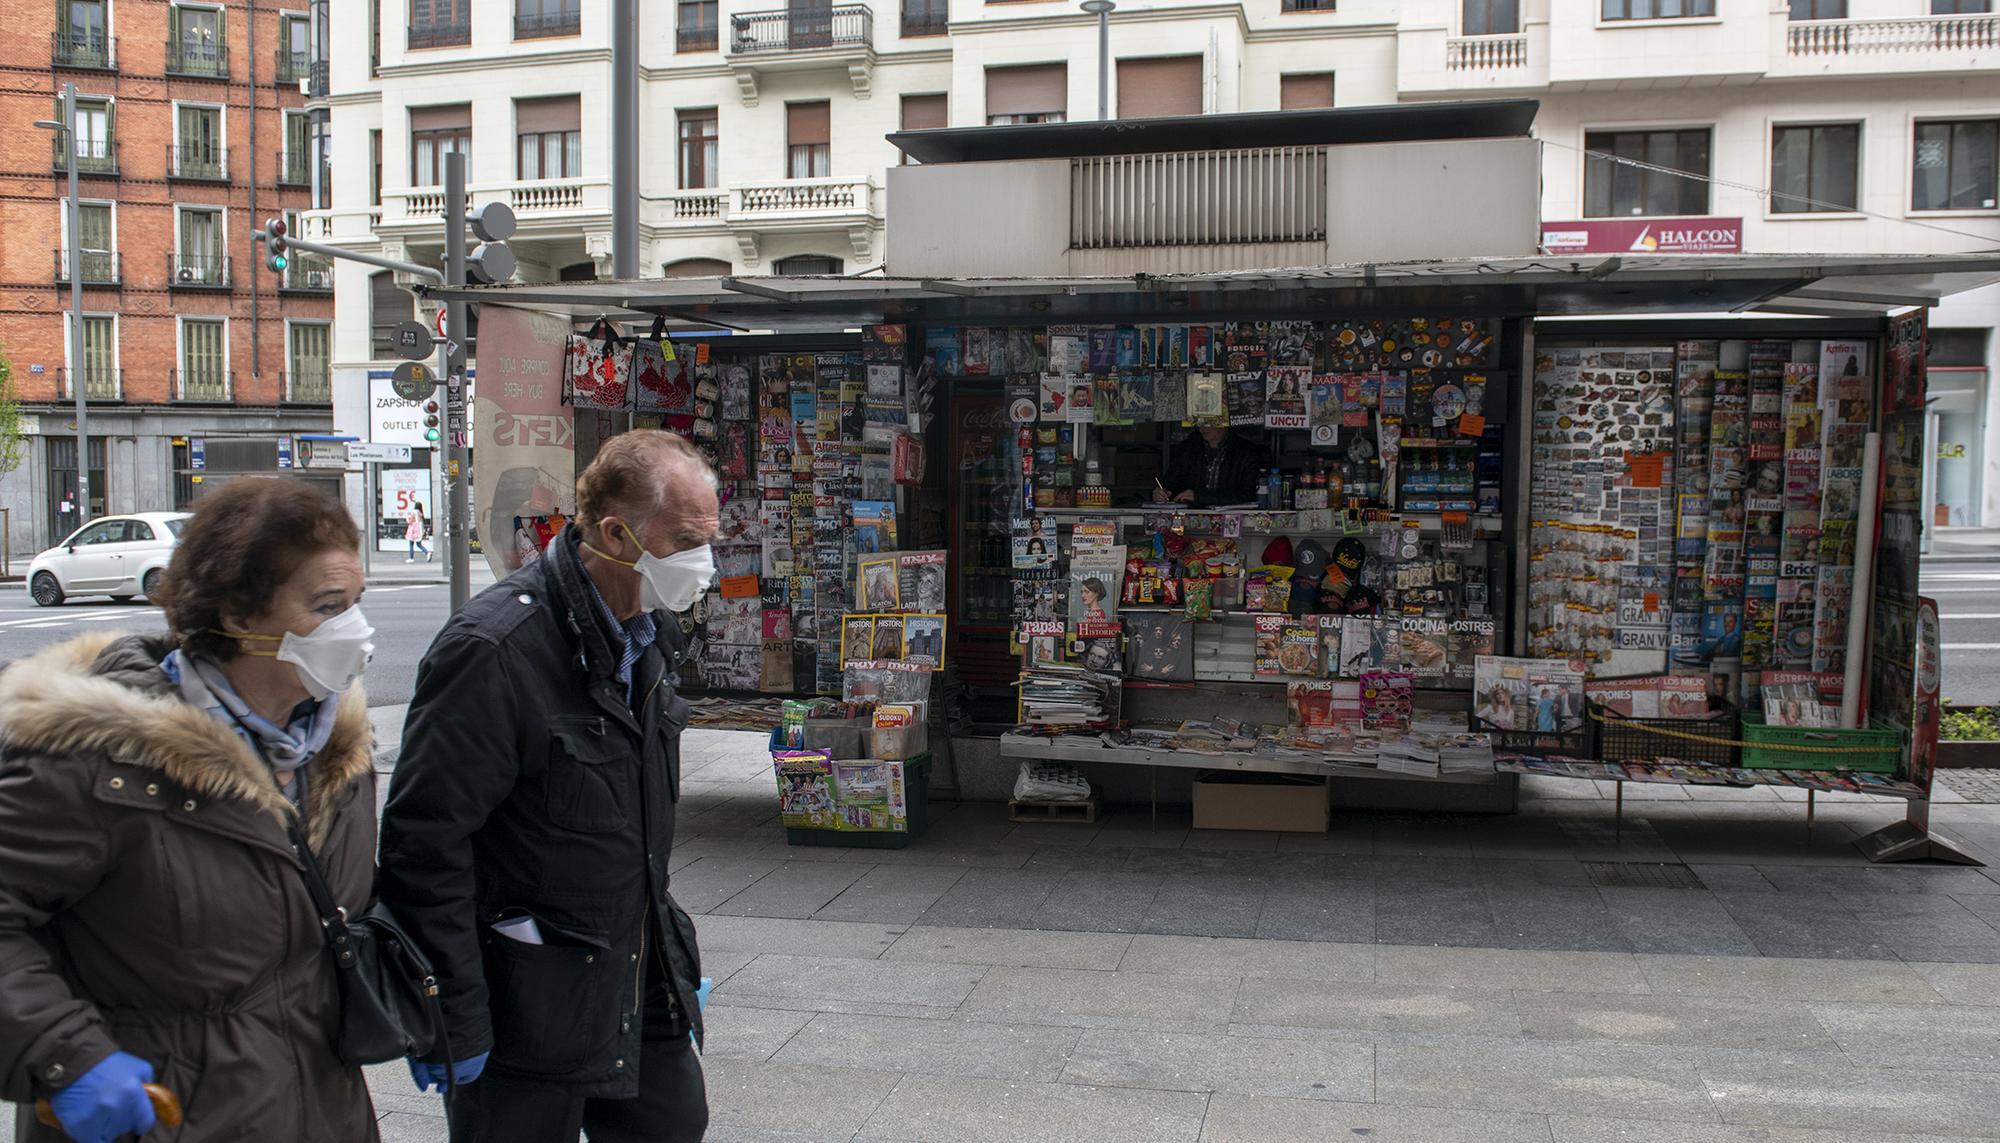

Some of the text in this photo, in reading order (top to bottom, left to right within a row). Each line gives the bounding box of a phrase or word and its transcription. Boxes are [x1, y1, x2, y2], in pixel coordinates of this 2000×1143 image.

[1659, 230, 1737, 244] HALCON
[382, 421, 418, 430] OUTLET
[1270, 417, 1306, 426] UNCUT
[1707, 575, 1743, 587] bikes
[1622, 607, 1652, 622] GRAN
[1023, 622, 1064, 635] Tapas
[1401, 619, 1447, 632] COCINA
[1449, 620, 1494, 632] POSTRES
[1285, 629, 1316, 637] Cocina
[1622, 633, 1655, 646] GRAN
